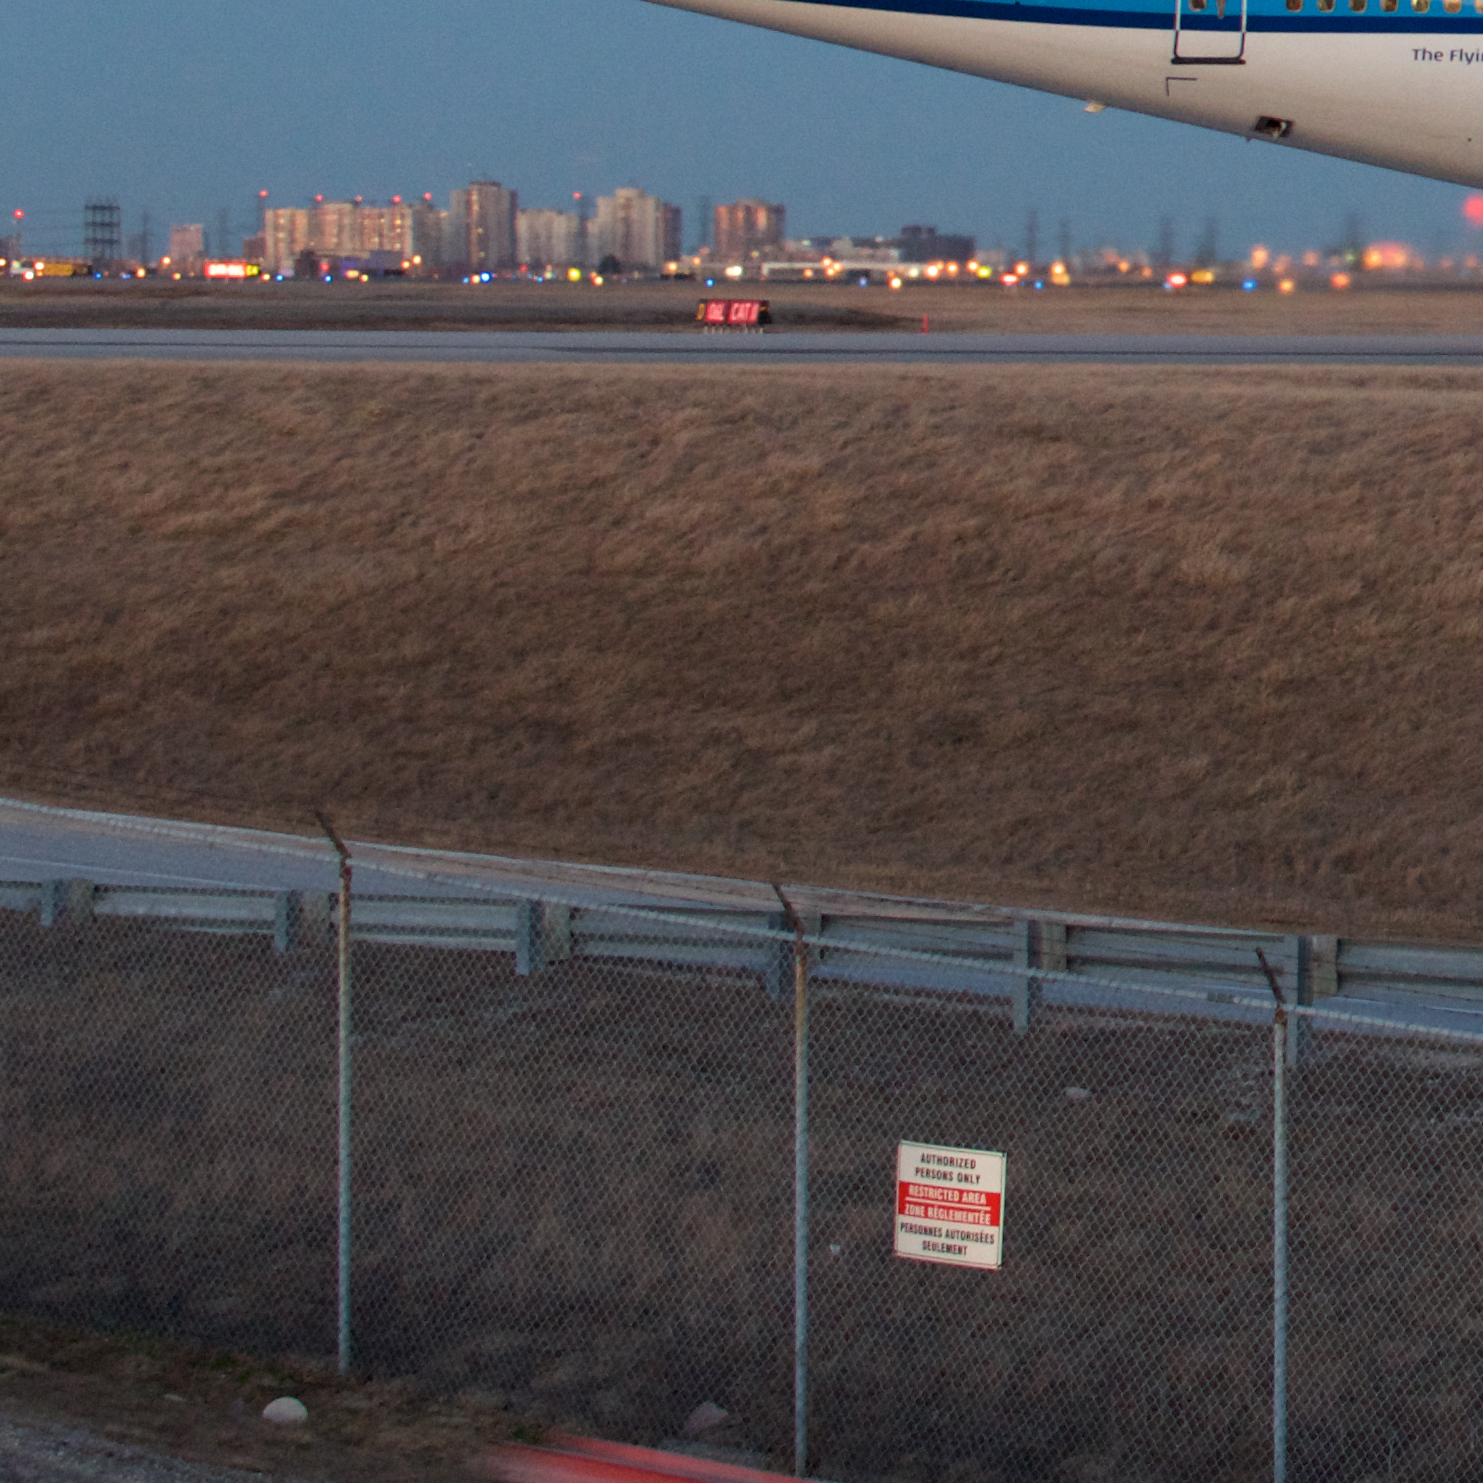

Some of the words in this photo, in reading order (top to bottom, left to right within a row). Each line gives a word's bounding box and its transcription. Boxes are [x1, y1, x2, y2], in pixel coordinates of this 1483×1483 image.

[1412, 48, 1444, 62] The
[920, 1153, 977, 1169] AUTHORIZED
[915, 1167, 954, 1182] PERSONS
[957, 1172, 981, 1184] ONLY
[908, 1184, 960, 1201] RESTRICTED
[961, 1192, 987, 1205] AREA
[904, 1203, 926, 1217] ZONE
[927, 1205, 991, 1225] RÉGLEMENTÉE
[900, 1222, 943, 1238] PERSONNES
[945, 1228, 995, 1245] AUTORISÉES
[922, 1240, 968, 1255] SEULEMENT
